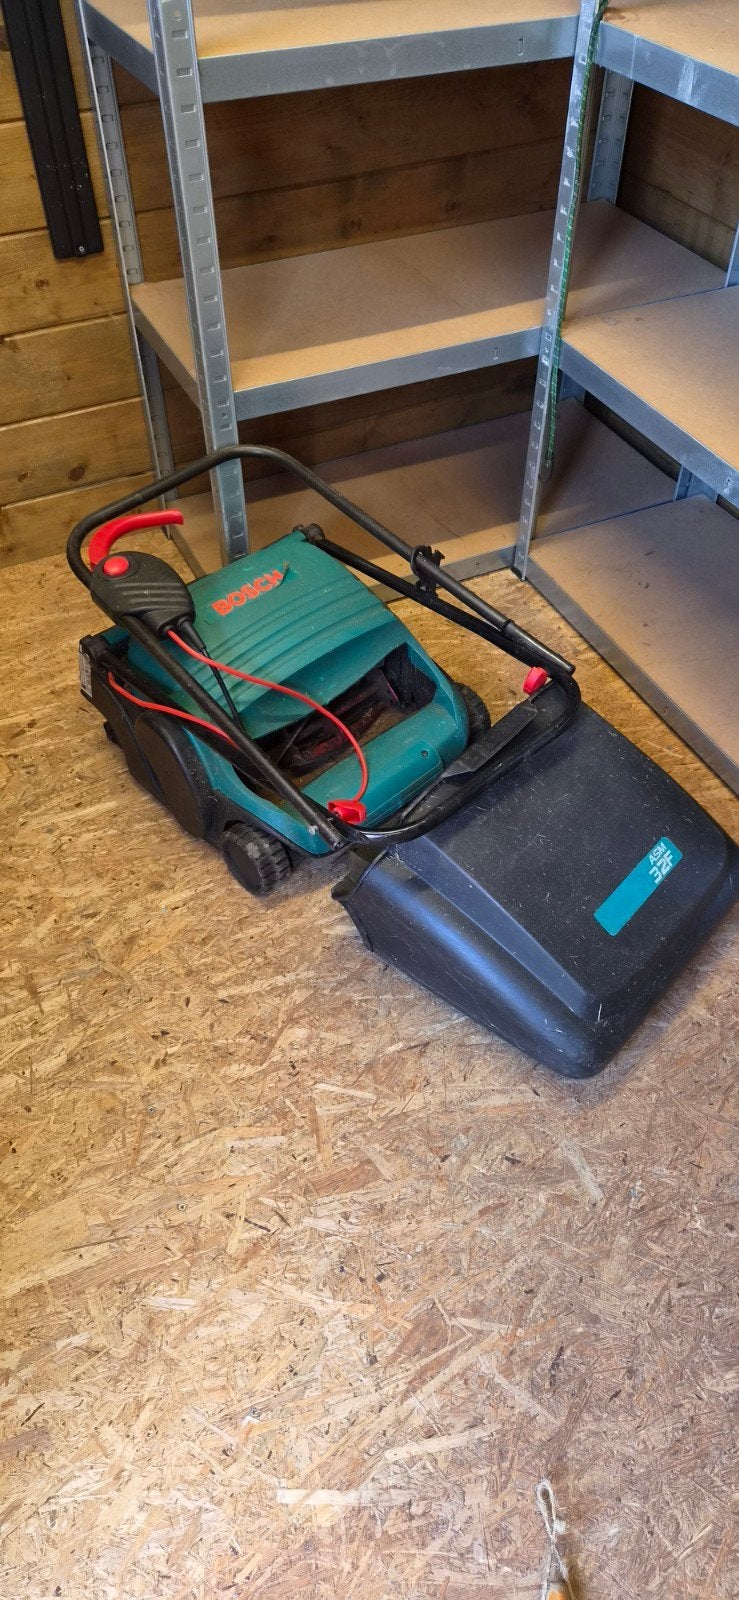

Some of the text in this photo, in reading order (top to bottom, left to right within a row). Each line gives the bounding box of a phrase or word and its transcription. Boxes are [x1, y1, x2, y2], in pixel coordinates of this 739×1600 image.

[211, 569, 284, 616] BOSCH
[648, 841, 667, 865] ASM
[648, 849, 674, 884] 32F
